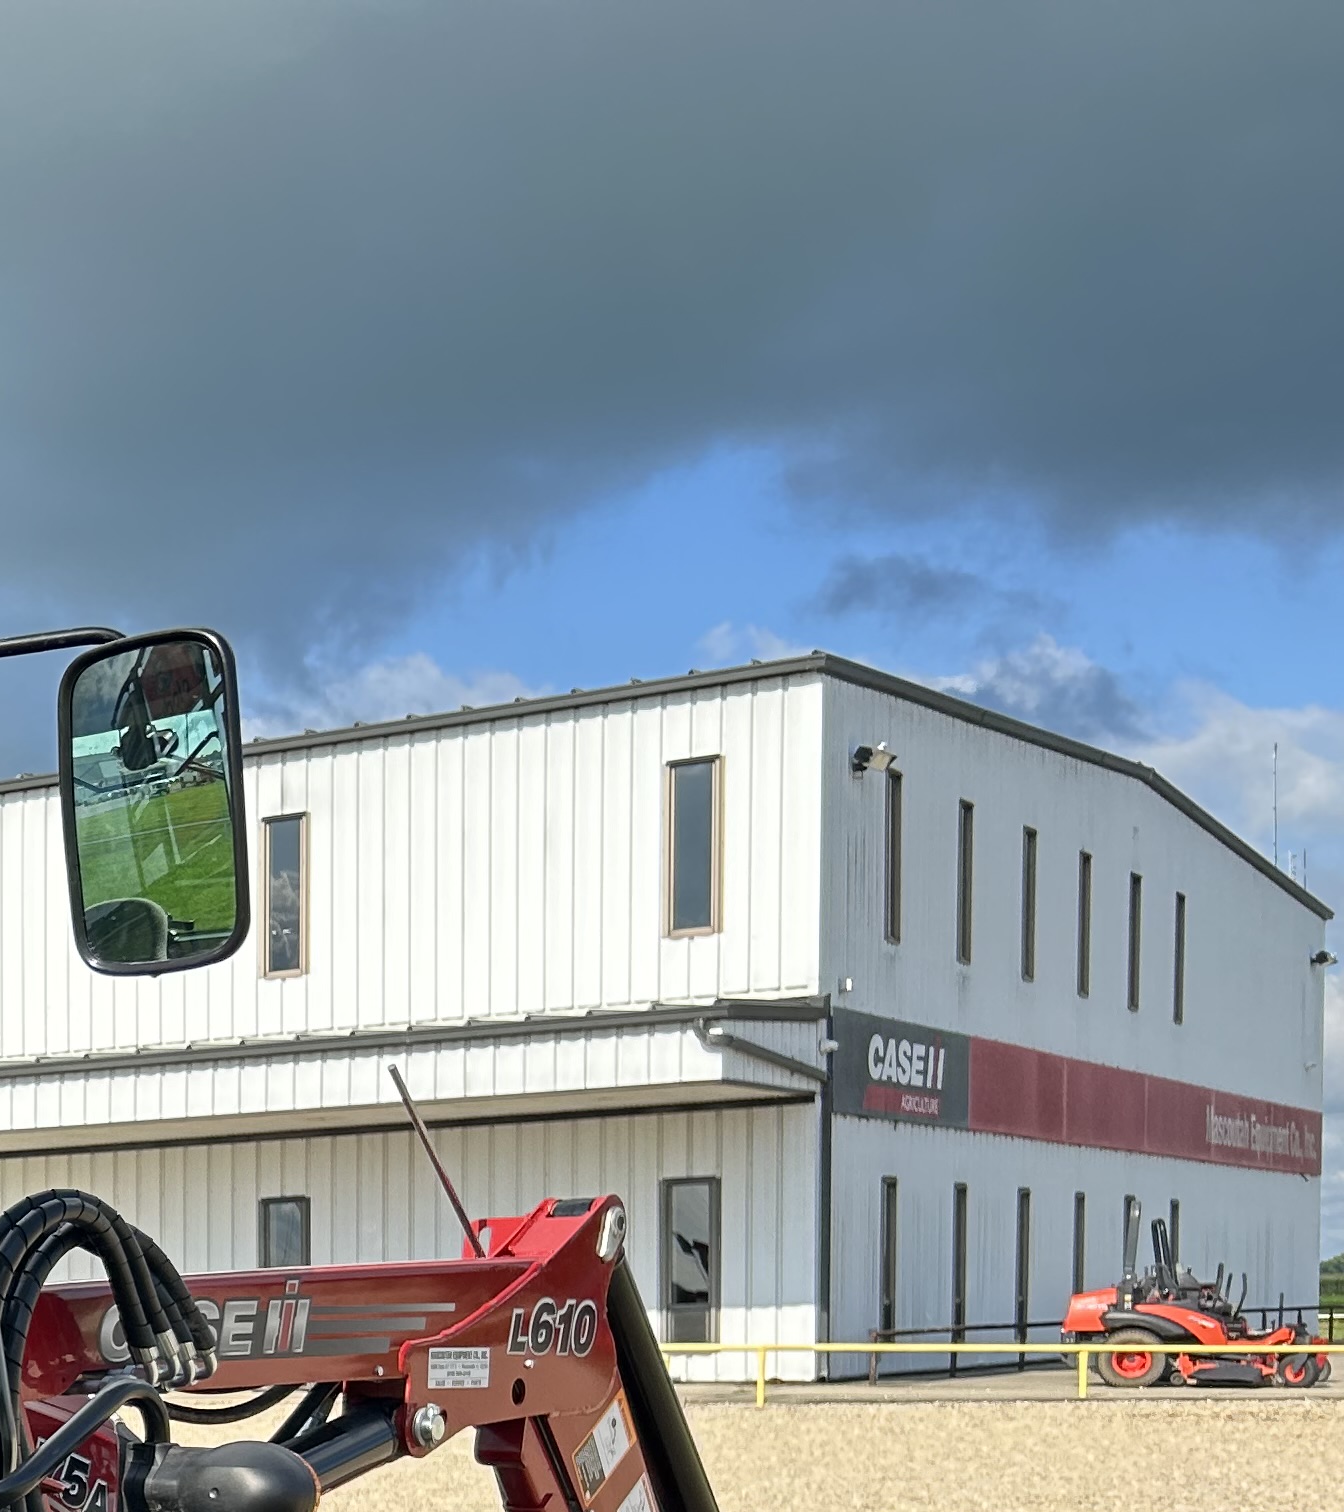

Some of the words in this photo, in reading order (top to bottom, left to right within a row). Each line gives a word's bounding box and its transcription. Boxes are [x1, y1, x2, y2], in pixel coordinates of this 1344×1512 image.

[868, 1033, 926, 1088] CASE
[900, 1094, 939, 1115] AGRICULTURE
[506, 1297, 598, 1358] L610
